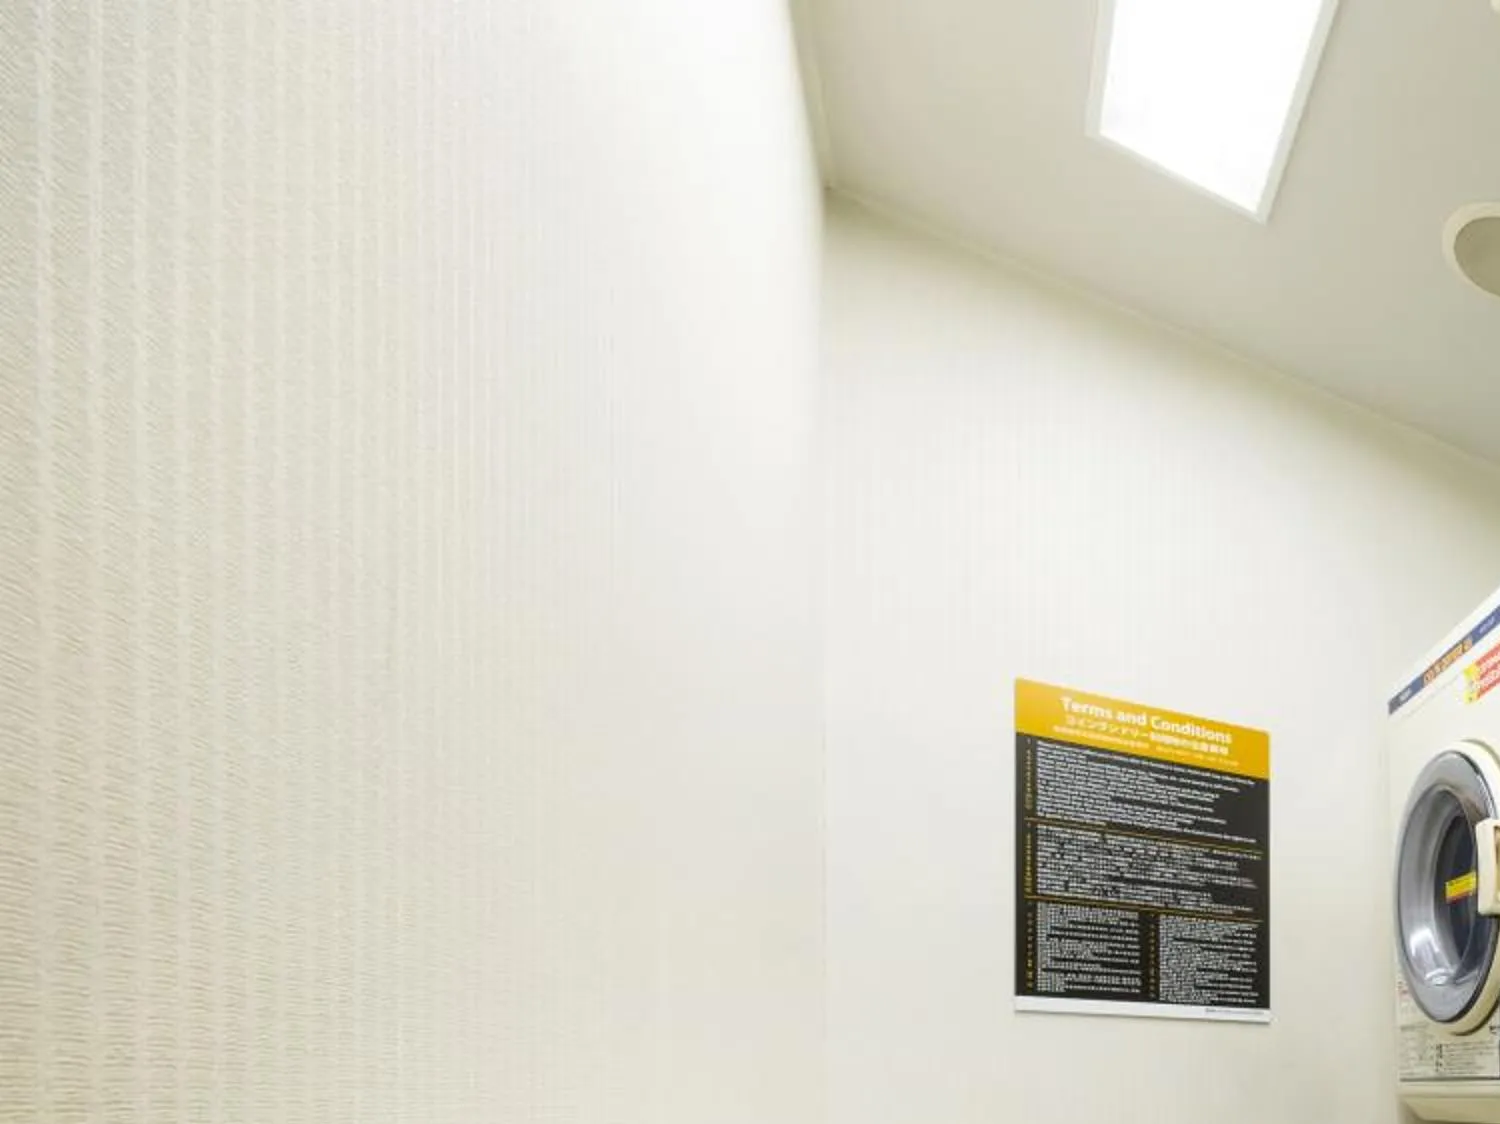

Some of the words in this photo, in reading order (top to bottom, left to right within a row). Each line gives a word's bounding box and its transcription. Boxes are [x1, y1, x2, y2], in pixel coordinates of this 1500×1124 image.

[1062, 697, 1113, 718] Terms
[1117, 711, 1147, 726] and
[1150, 715, 1232, 744] Conditions
